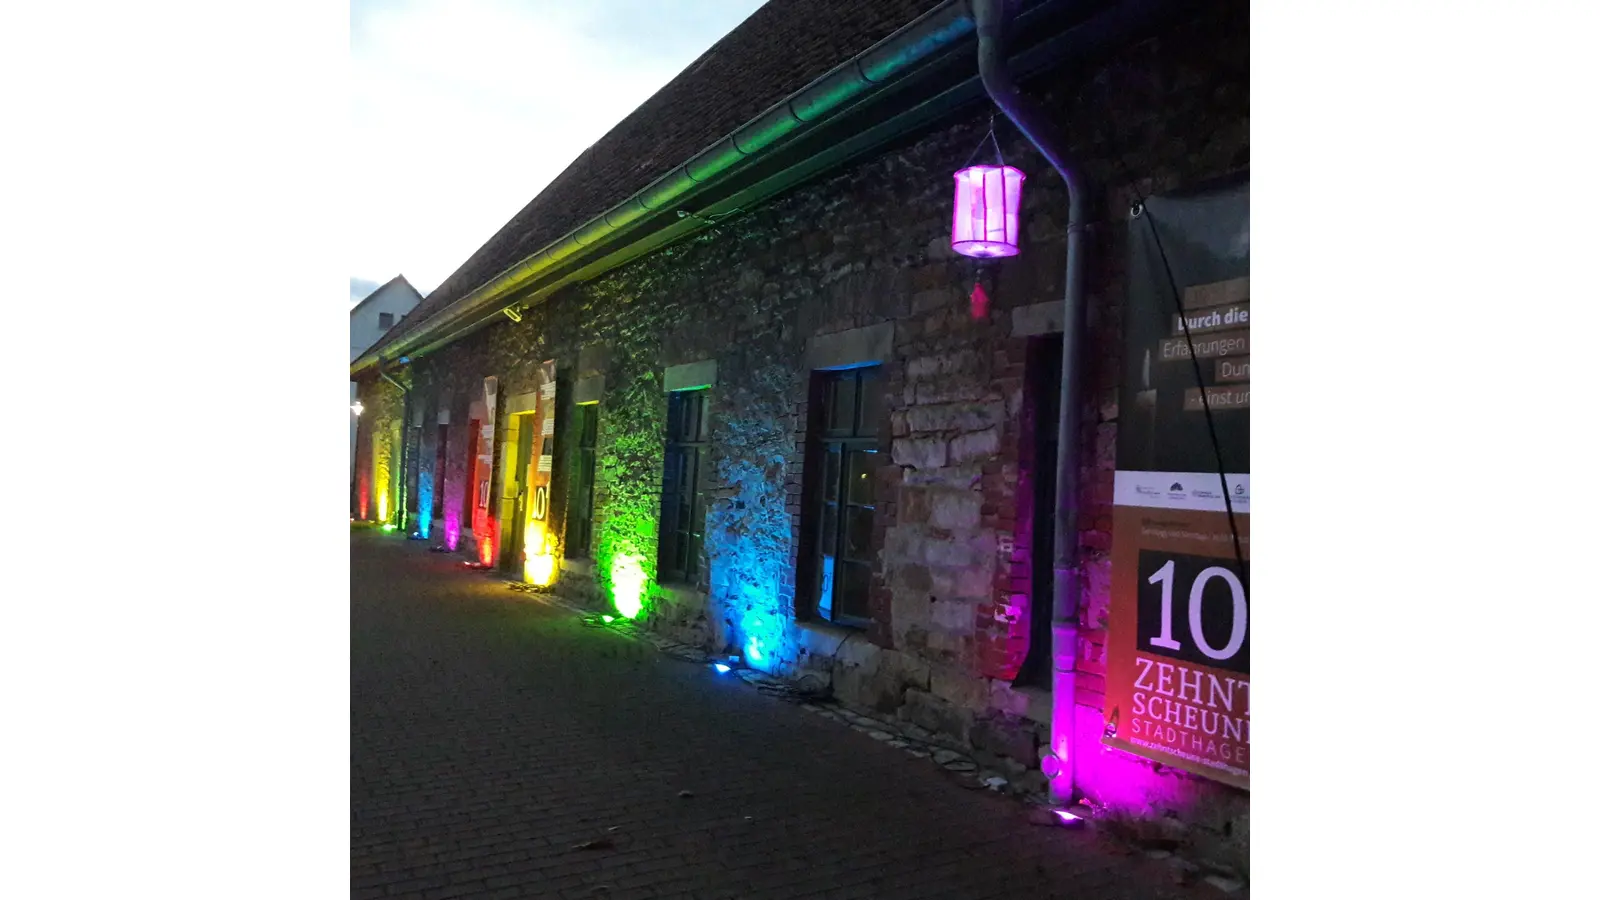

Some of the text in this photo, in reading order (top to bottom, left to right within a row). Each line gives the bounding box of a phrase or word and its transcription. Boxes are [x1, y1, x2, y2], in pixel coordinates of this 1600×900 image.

[1178, 307, 1249, 331] Durch die
[1148, 559, 1248, 660] 10
